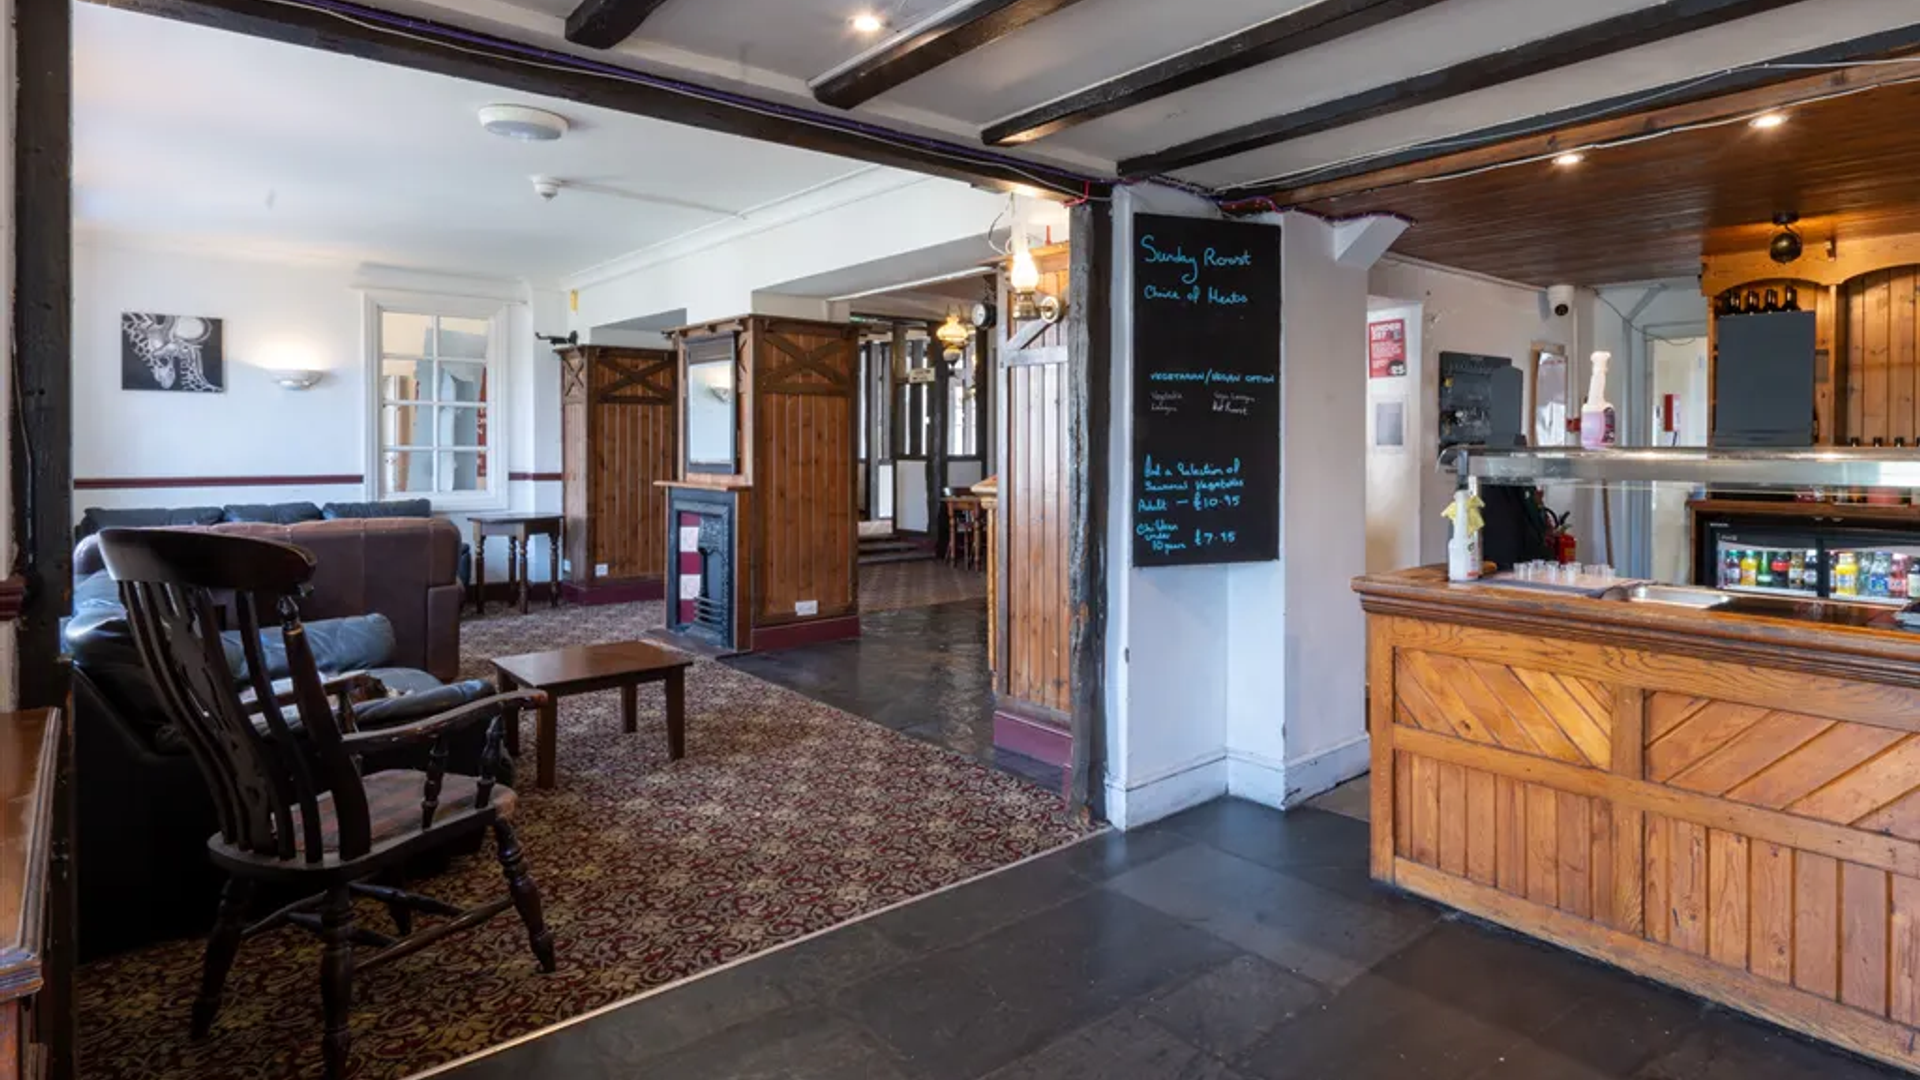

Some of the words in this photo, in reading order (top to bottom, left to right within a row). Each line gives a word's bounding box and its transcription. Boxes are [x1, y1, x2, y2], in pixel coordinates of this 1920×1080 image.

[1140, 234, 1198, 284] Sunday
[1203, 247, 1251, 266] Roast
[1144, 285, 1180, 299] Choice
[1187, 285, 1201, 304] of
[1208, 286, 1248, 304] Meats
[1226, 457, 1240, 474] of
[1138, 498, 1167, 512] Adult
